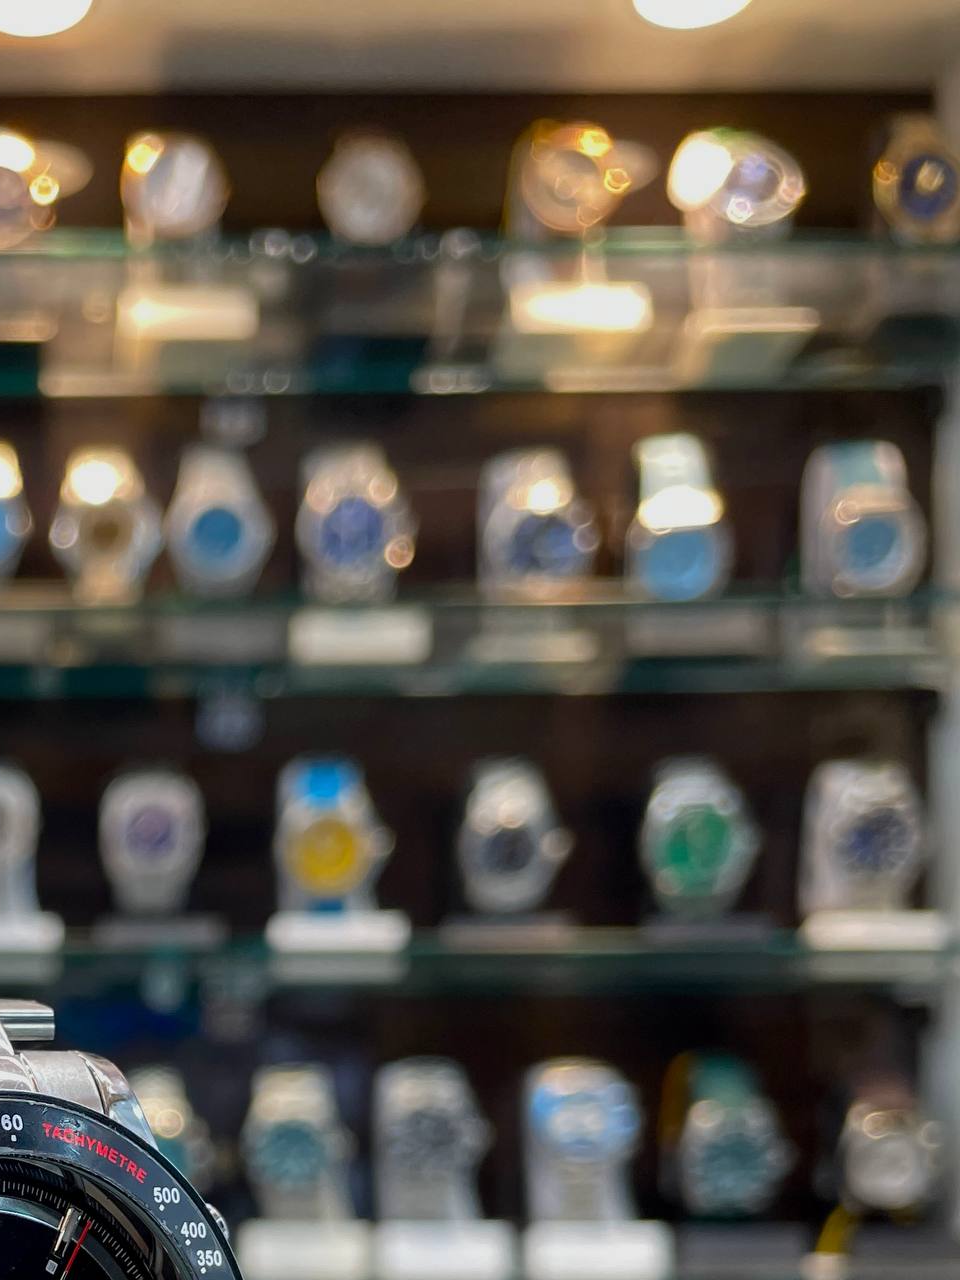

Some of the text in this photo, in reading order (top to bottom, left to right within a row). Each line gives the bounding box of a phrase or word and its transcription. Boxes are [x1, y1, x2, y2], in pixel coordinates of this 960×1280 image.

[1, 1114, 23, 1131] 60
[42, 1122, 148, 1184] TACHYMETRE
[153, 1186, 180, 1204] 500
[180, 1221, 206, 1239] 400
[197, 1249, 222, 1267] 350
